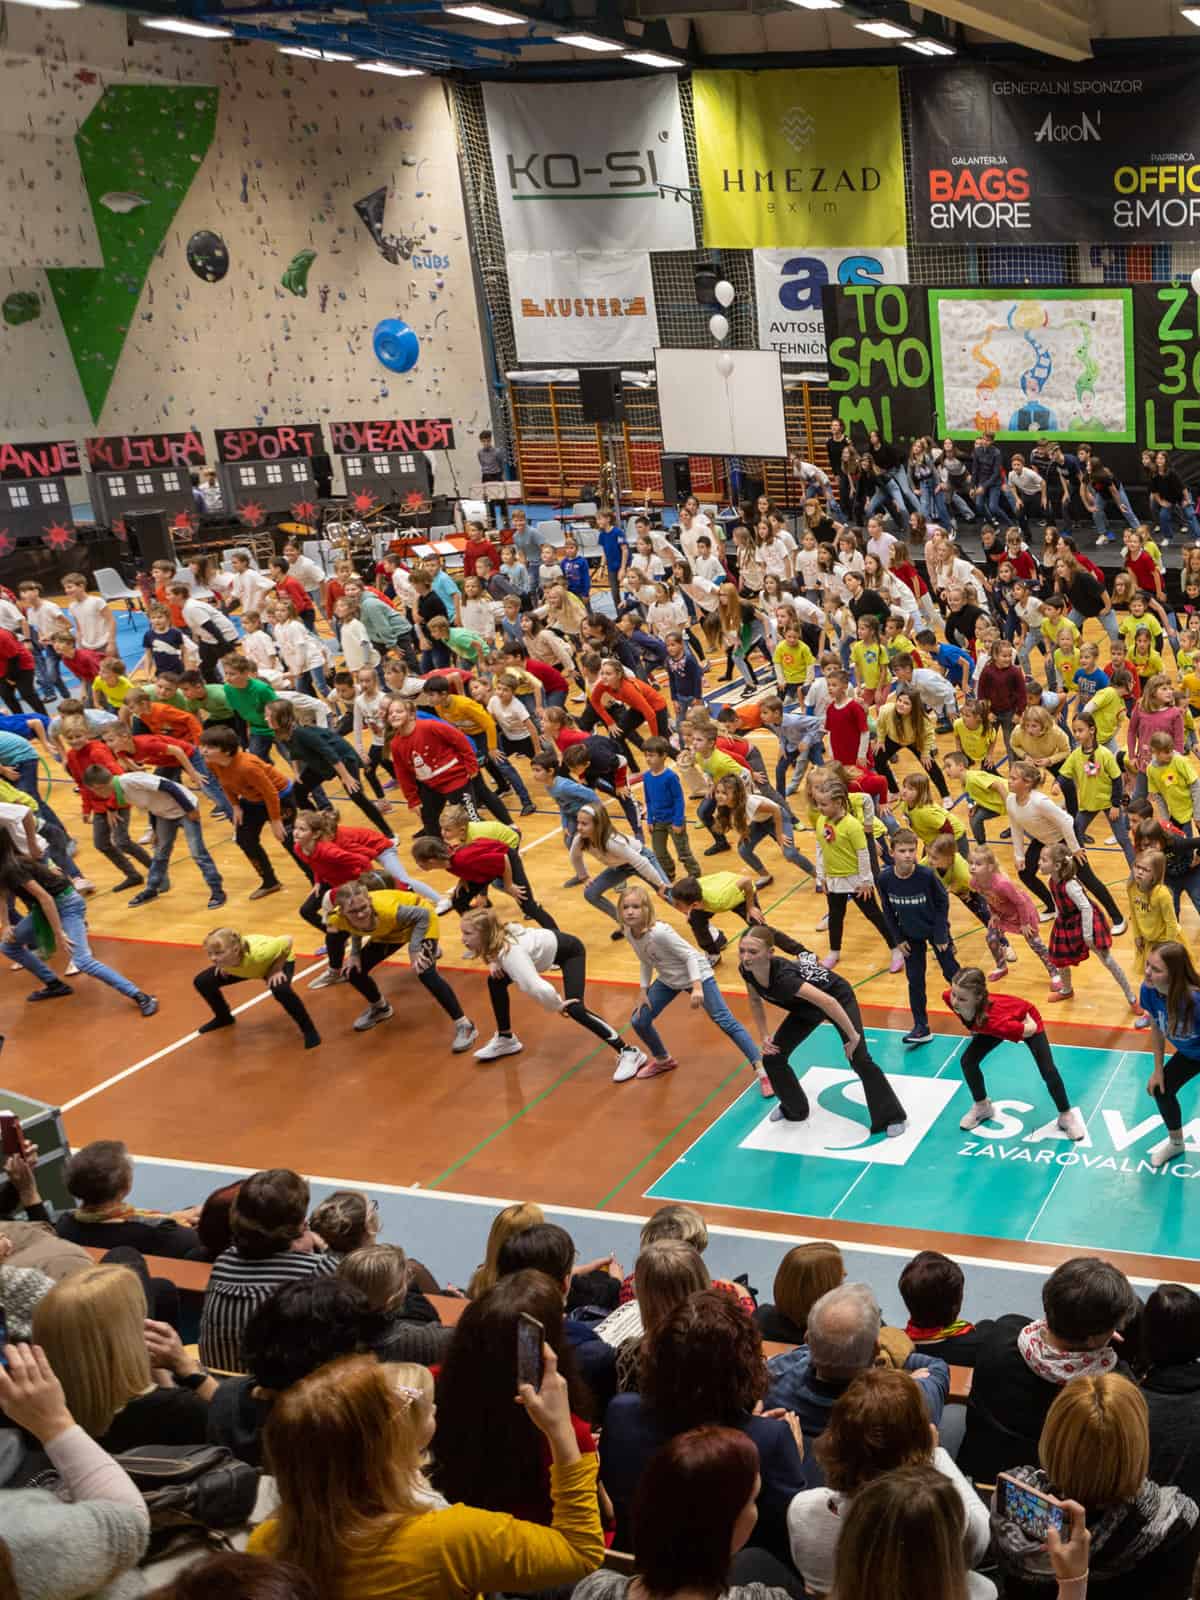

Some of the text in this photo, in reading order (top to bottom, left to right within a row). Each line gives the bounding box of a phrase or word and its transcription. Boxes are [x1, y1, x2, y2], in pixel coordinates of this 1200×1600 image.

[992, 79, 1143, 96] GENERALNI SPONZOR
[506, 150, 659, 189] KO-SI
[951, 155, 1008, 166] GALANTERIJA
[722, 167, 882, 193] HMEZAD
[929, 167, 1032, 202] BAGS
[766, 201, 838, 214] exim
[930, 202, 1032, 229] &MORE
[545, 297, 623, 317] KUSTER
[844, 285, 908, 336] TO
[770, 322, 825, 334] AVTOSE
[829, 337, 931, 391] SMO
[223, 427, 315, 460] ŠPORT
[331, 419, 454, 452] POVEZANOST
[85, 432, 205, 470] KULTURA
